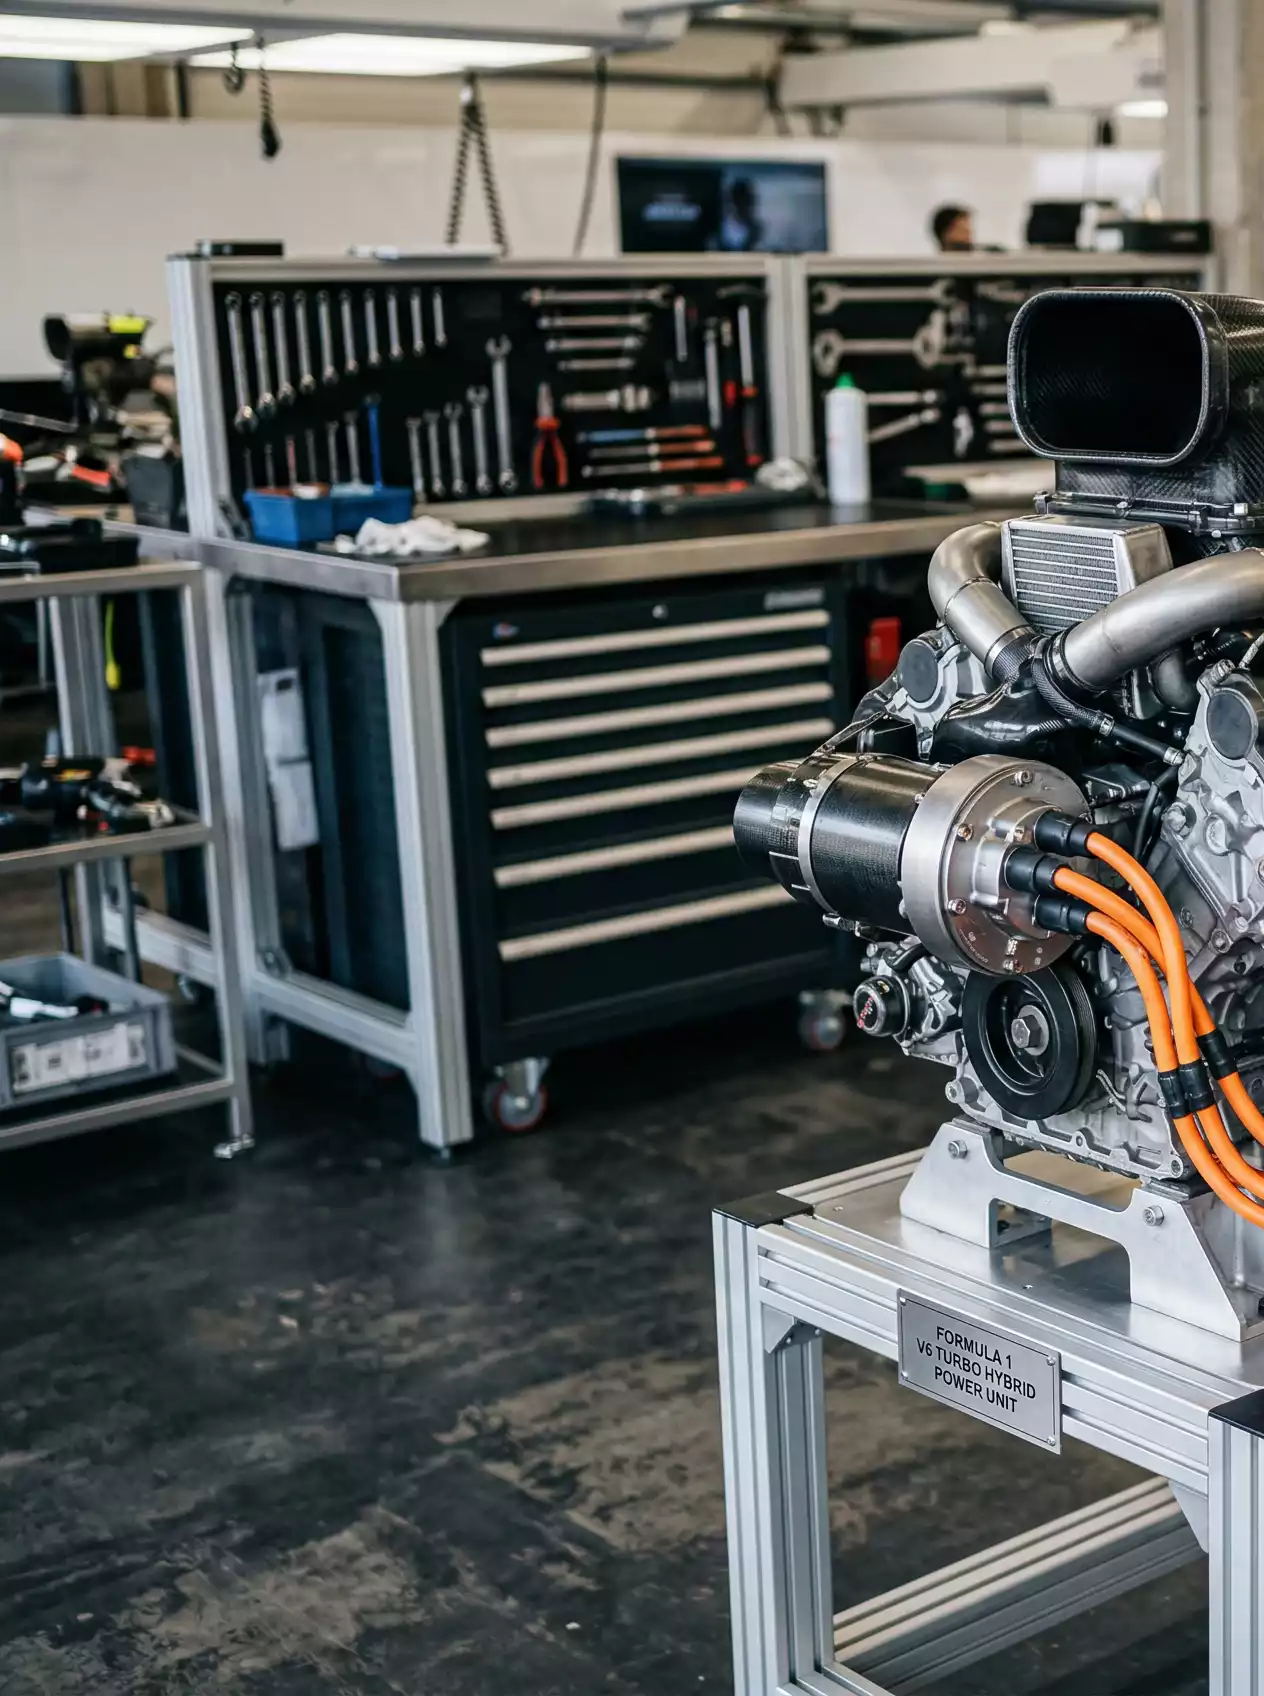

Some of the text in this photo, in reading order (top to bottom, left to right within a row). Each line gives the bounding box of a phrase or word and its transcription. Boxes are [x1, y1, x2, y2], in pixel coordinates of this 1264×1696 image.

[916, 1337, 1035, 1399] V6 TURBO HYBRID
[937, 1326, 1012, 1369] FORMULA 1
[935, 1366, 1017, 1412] POWER UNIT
